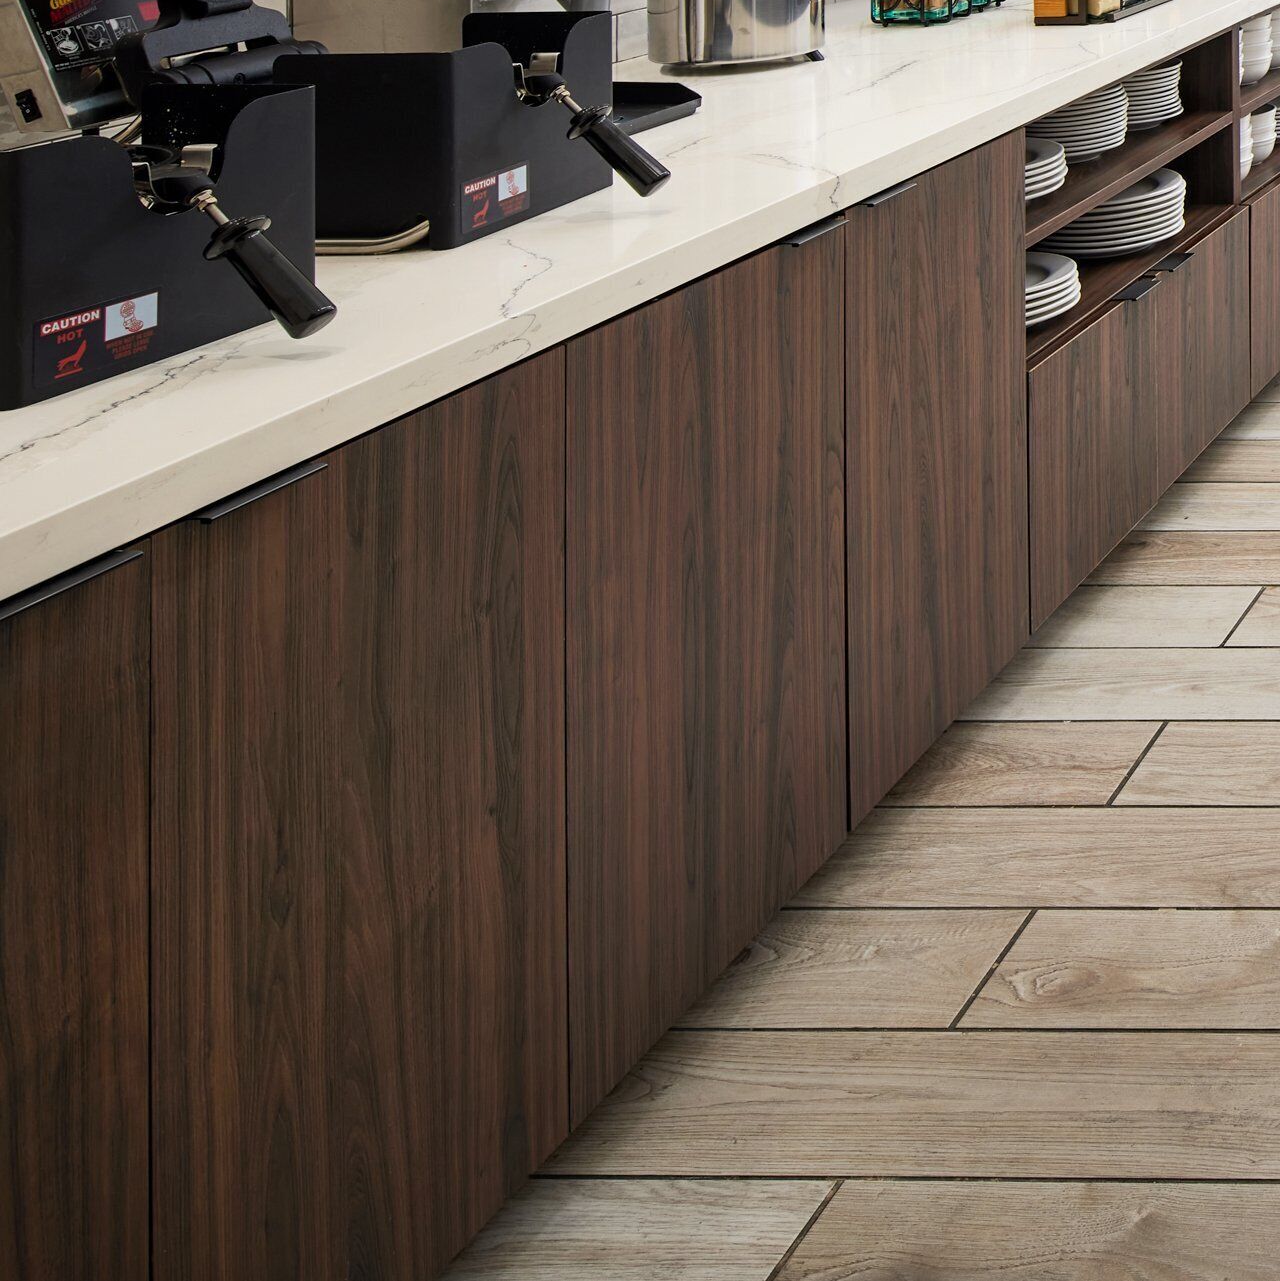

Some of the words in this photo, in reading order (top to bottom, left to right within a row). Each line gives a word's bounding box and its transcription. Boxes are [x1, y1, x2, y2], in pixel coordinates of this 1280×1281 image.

[464, 176, 496, 194] CAUTION
[41, 309, 100, 334] CAUTION
[57, 329, 84, 344] HOT
